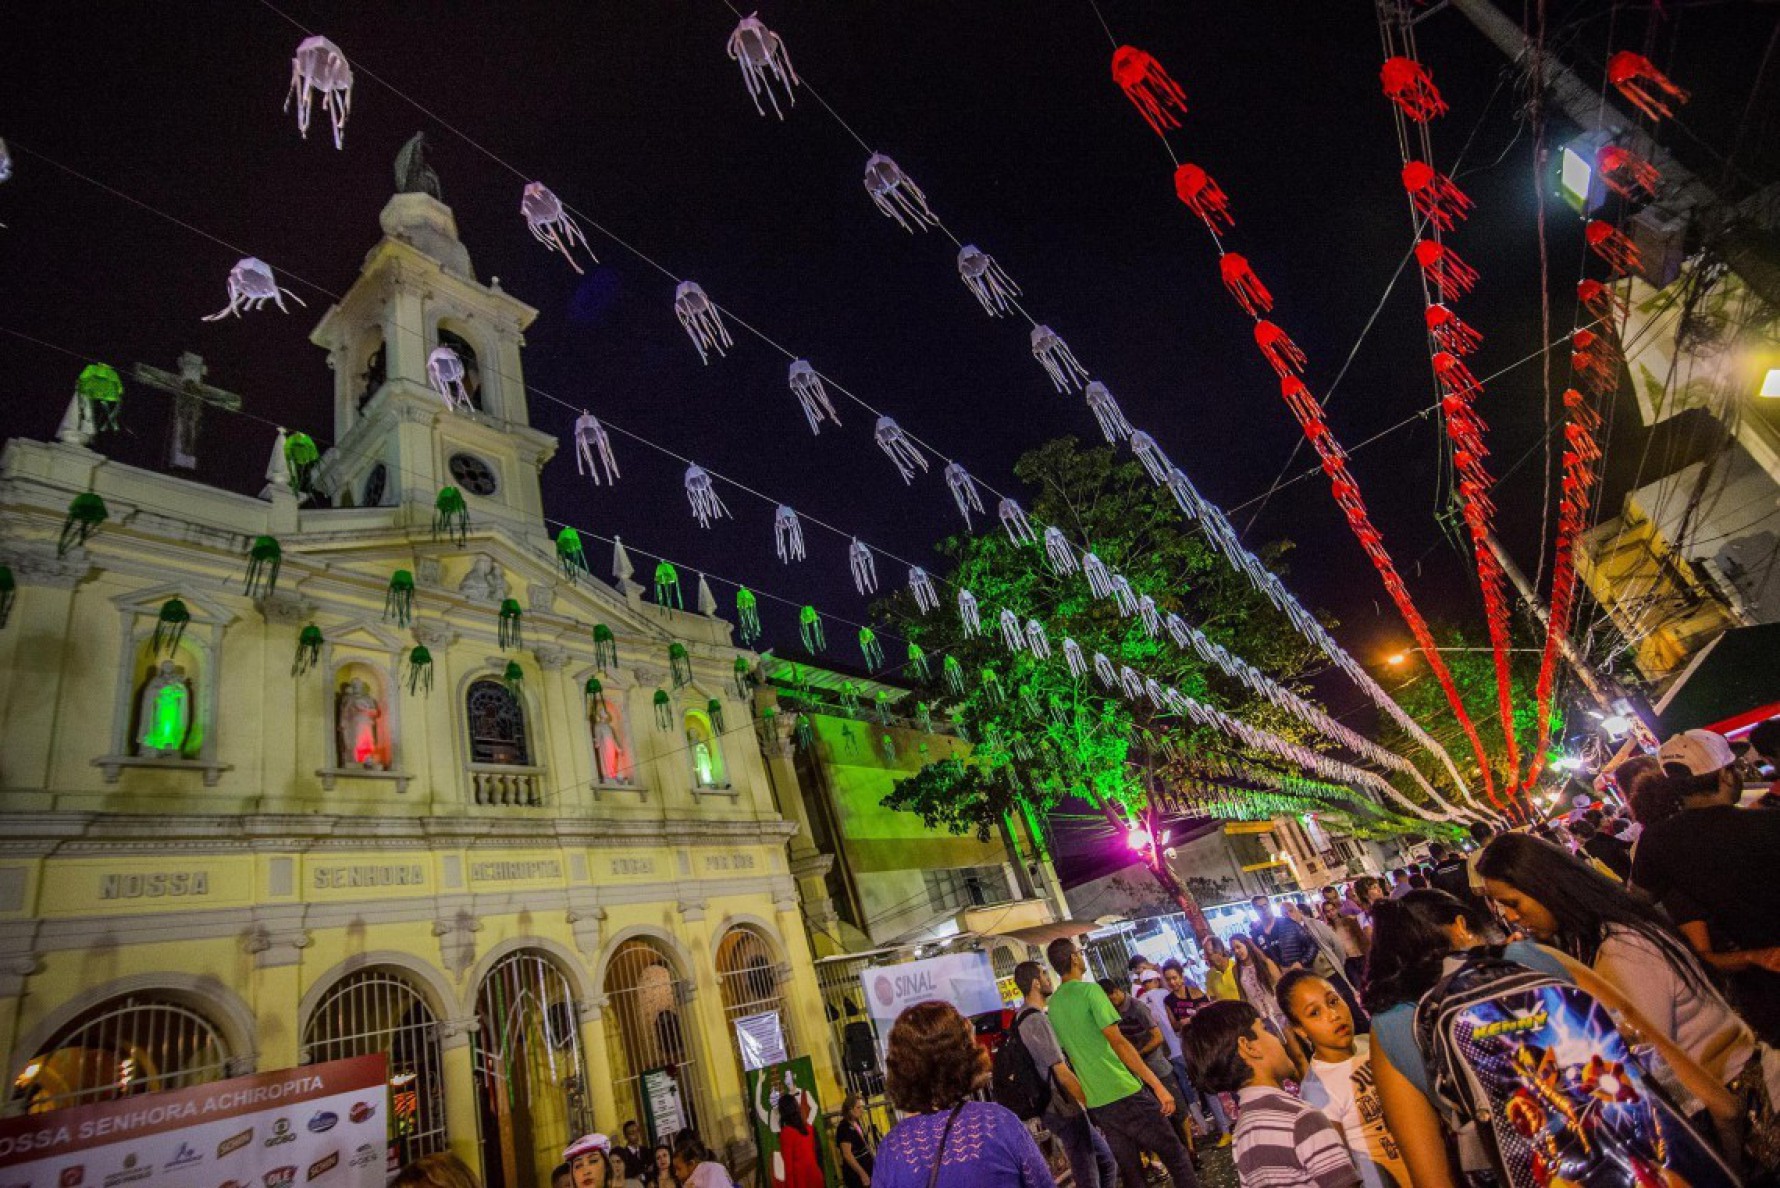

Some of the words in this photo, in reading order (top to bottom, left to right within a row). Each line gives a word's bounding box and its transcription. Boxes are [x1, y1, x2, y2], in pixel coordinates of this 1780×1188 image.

[102, 871, 208, 899] NOSSA
[314, 865, 424, 889] SENHORA
[895, 970, 937, 997] SINAL
[78, 1100, 198, 1140] SENHORA
[202, 1074, 324, 1113] ACHIROPITA
